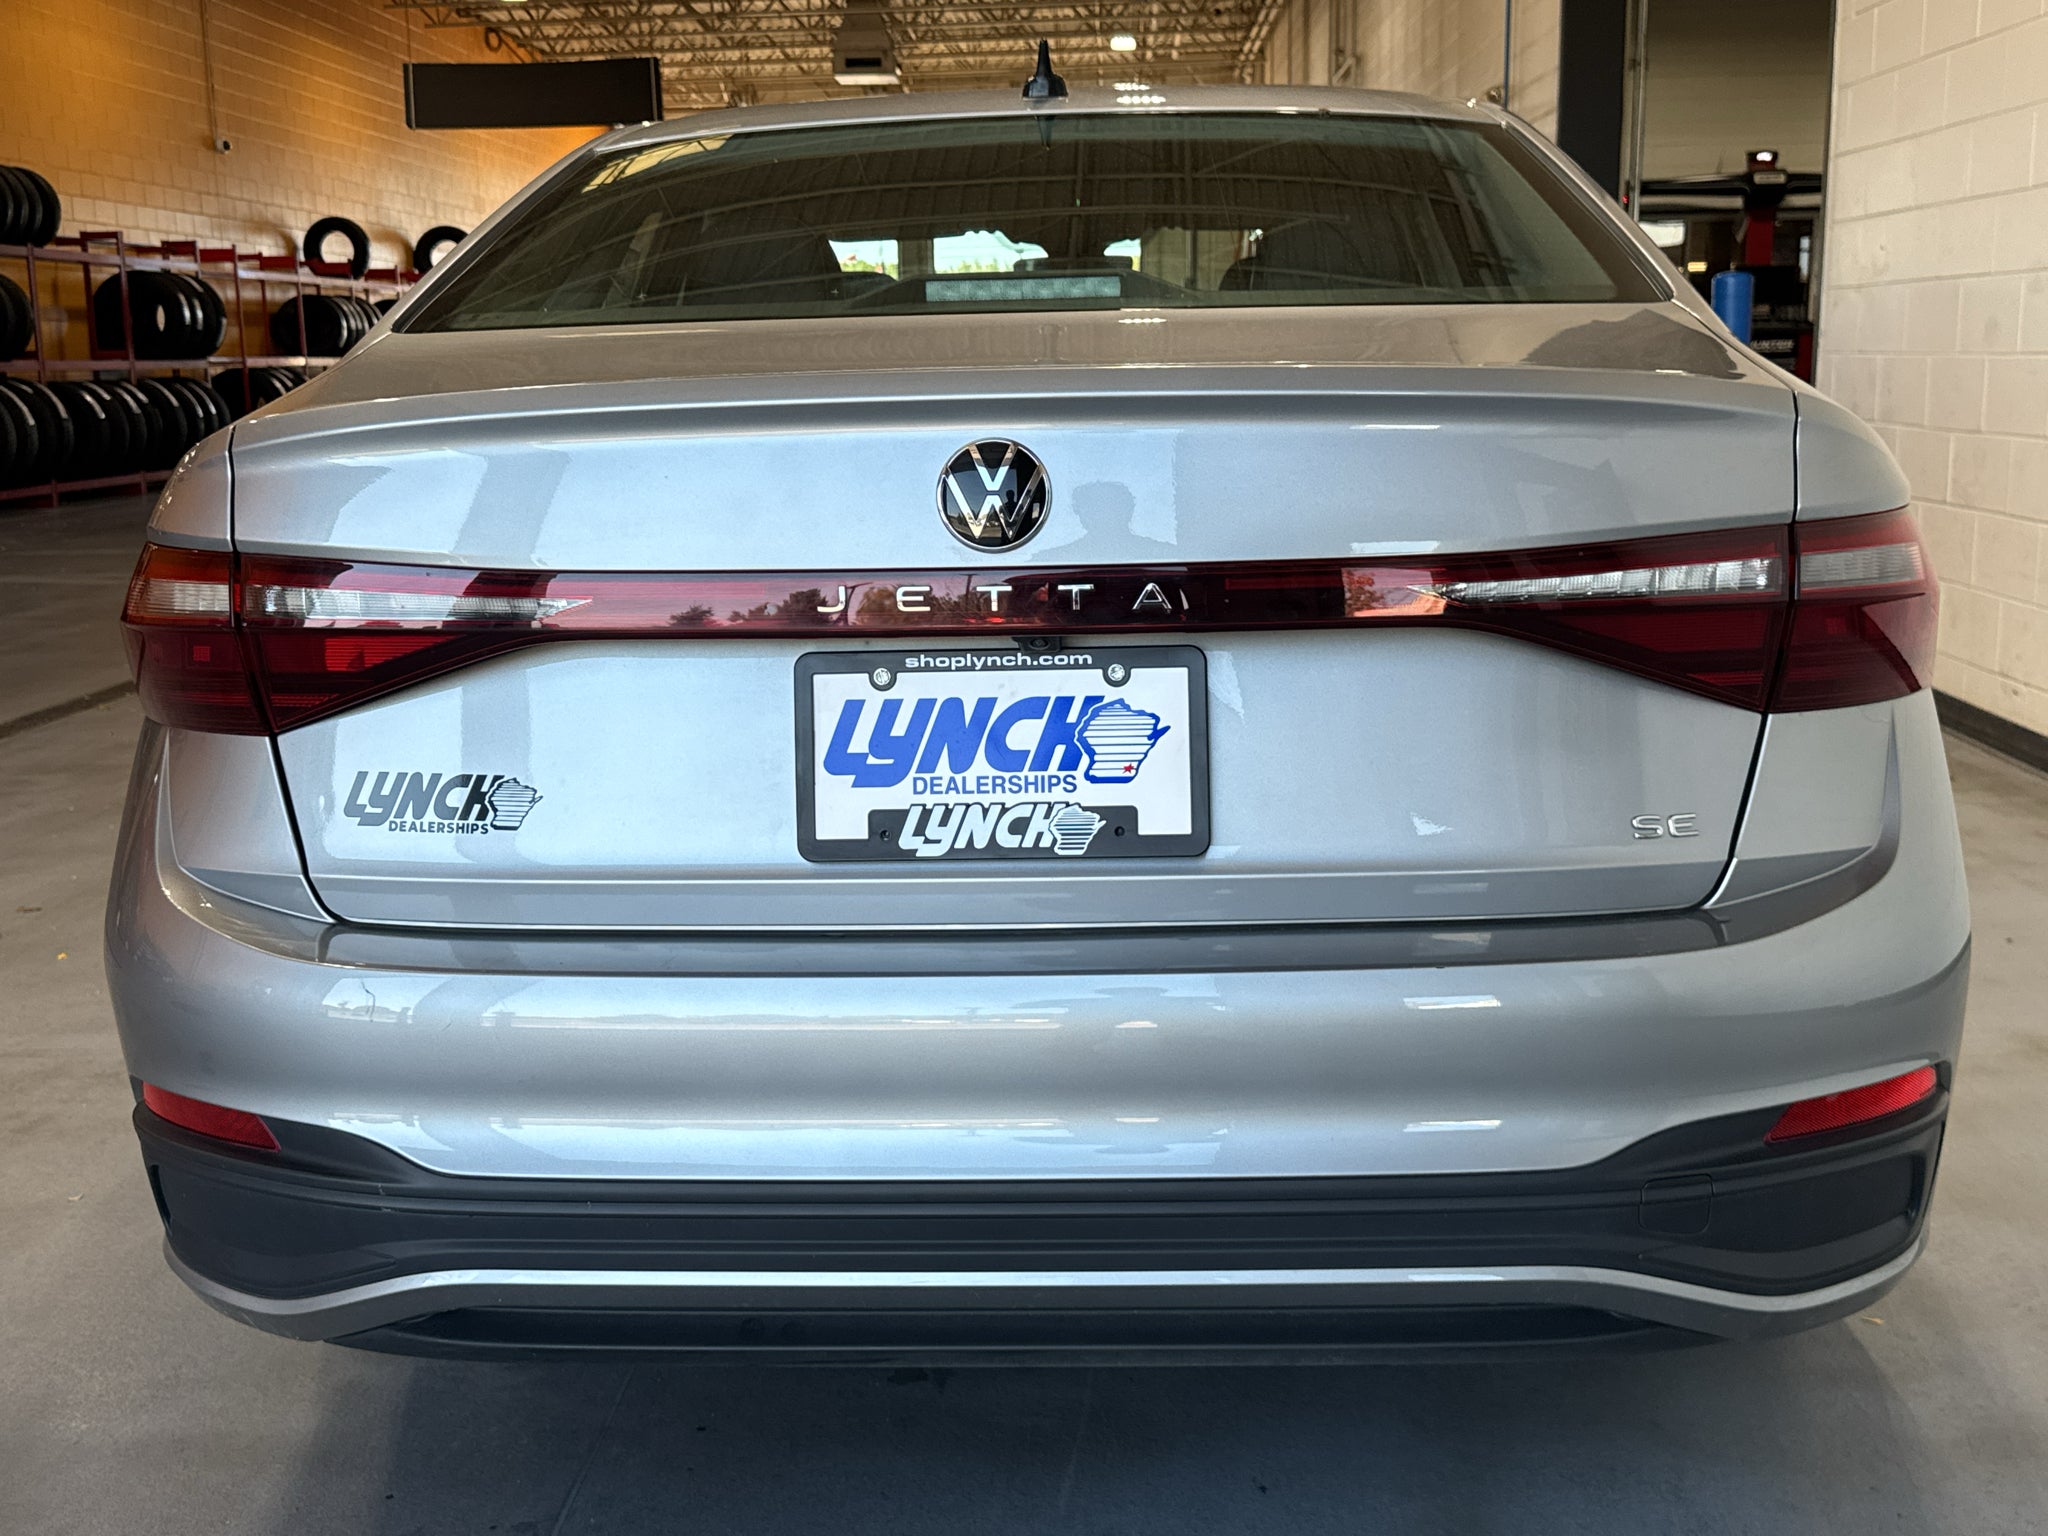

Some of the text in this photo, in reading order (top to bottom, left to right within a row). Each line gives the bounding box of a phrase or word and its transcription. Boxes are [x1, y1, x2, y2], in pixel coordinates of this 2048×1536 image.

[816, 582, 1173, 613] JETTA
[904, 652, 1093, 670] shoplynch.com
[823, 695, 1105, 788] LYNCH
[343, 771, 505, 827] LYNCH
[912, 775, 1078, 795] DEALERSHIPS
[388, 820, 489, 835] DEALERSHIPS
[898, 801, 1070, 857] LYNCH
[1631, 813, 1699, 839] SE
